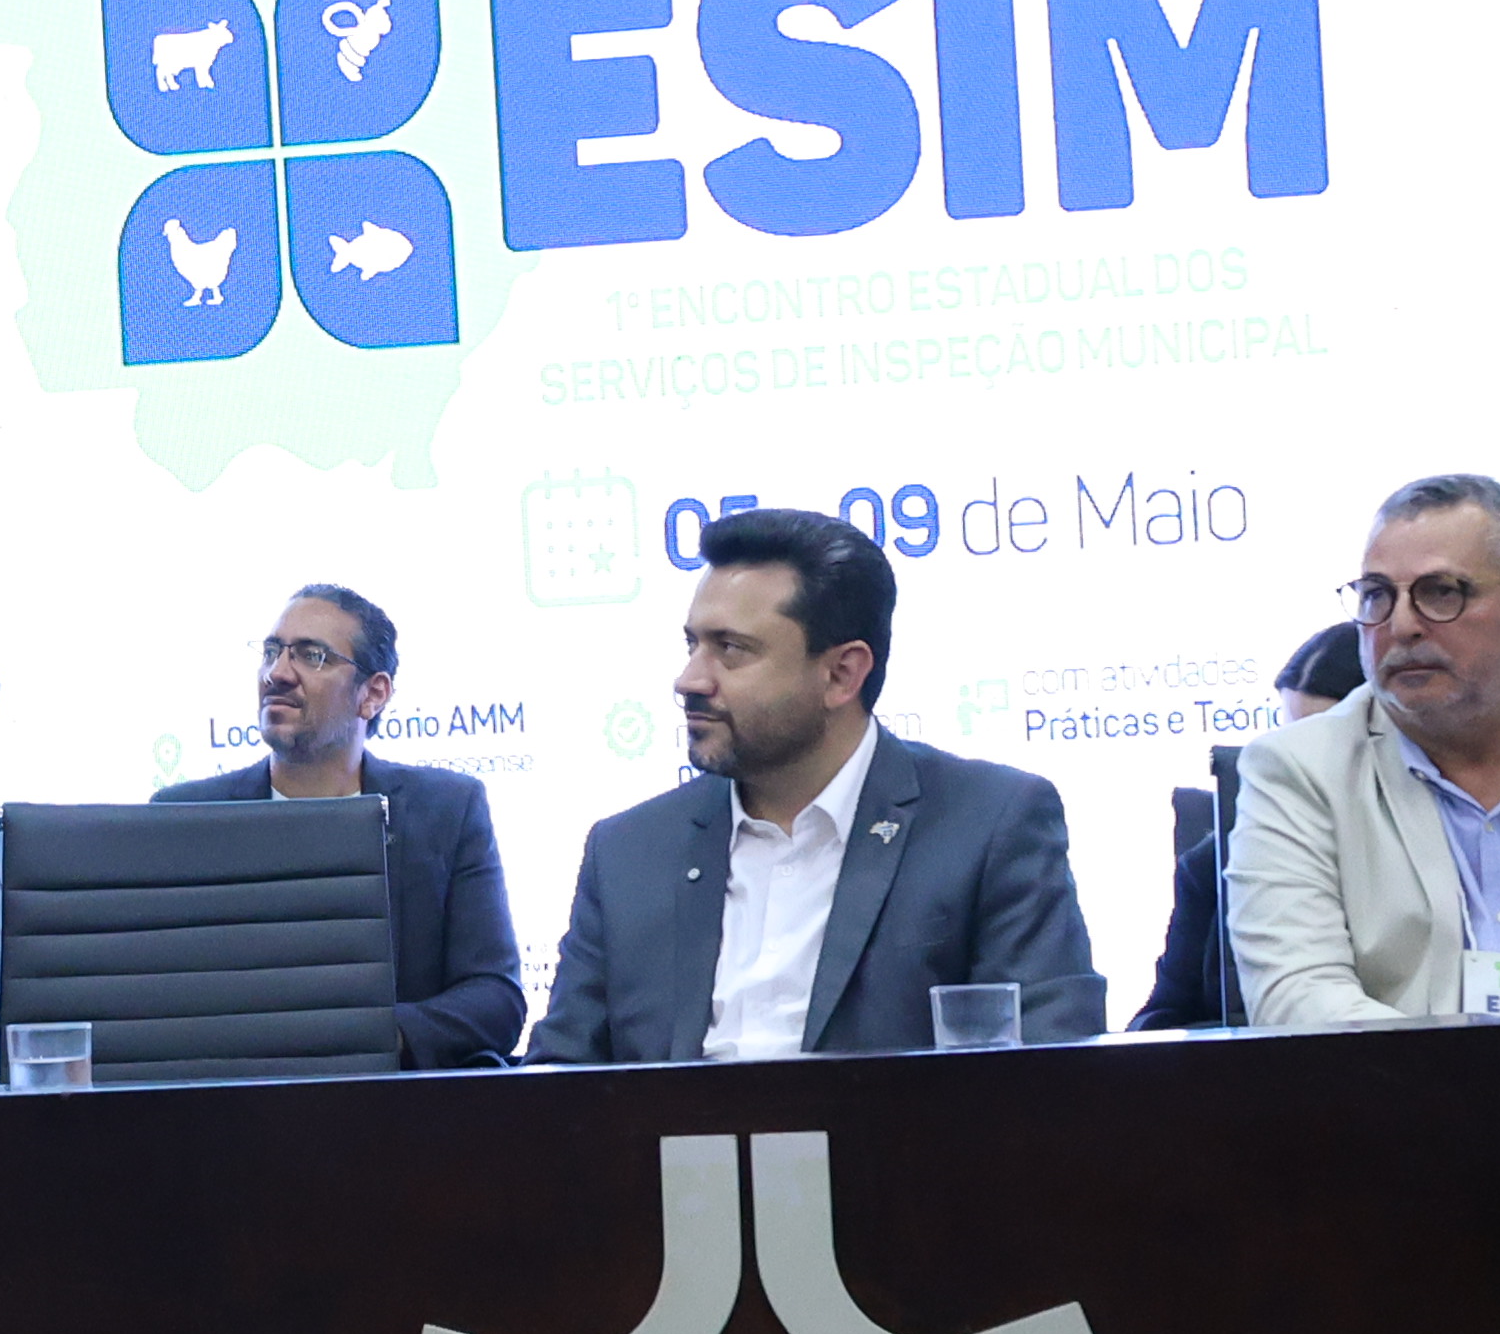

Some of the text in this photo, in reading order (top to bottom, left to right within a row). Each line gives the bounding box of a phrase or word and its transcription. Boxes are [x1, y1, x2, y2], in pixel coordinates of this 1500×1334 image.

[652, 270, 895, 331] ENCONTRO
[910, 255, 1145, 313] ESTADUAL
[1156, 246, 1249, 295] DOS
[539, 313, 1330, 410] SERVIÇOS DE INSPEÇÃO MUNICIPAL
[664, 468, 1248, 571] 0 09 de Maio
[1022, 653, 1258, 697] com atividades
[447, 701, 526, 737] AMM
[1024, 707, 1160, 742] Práticas
[1166, 711, 1185, 734] e
